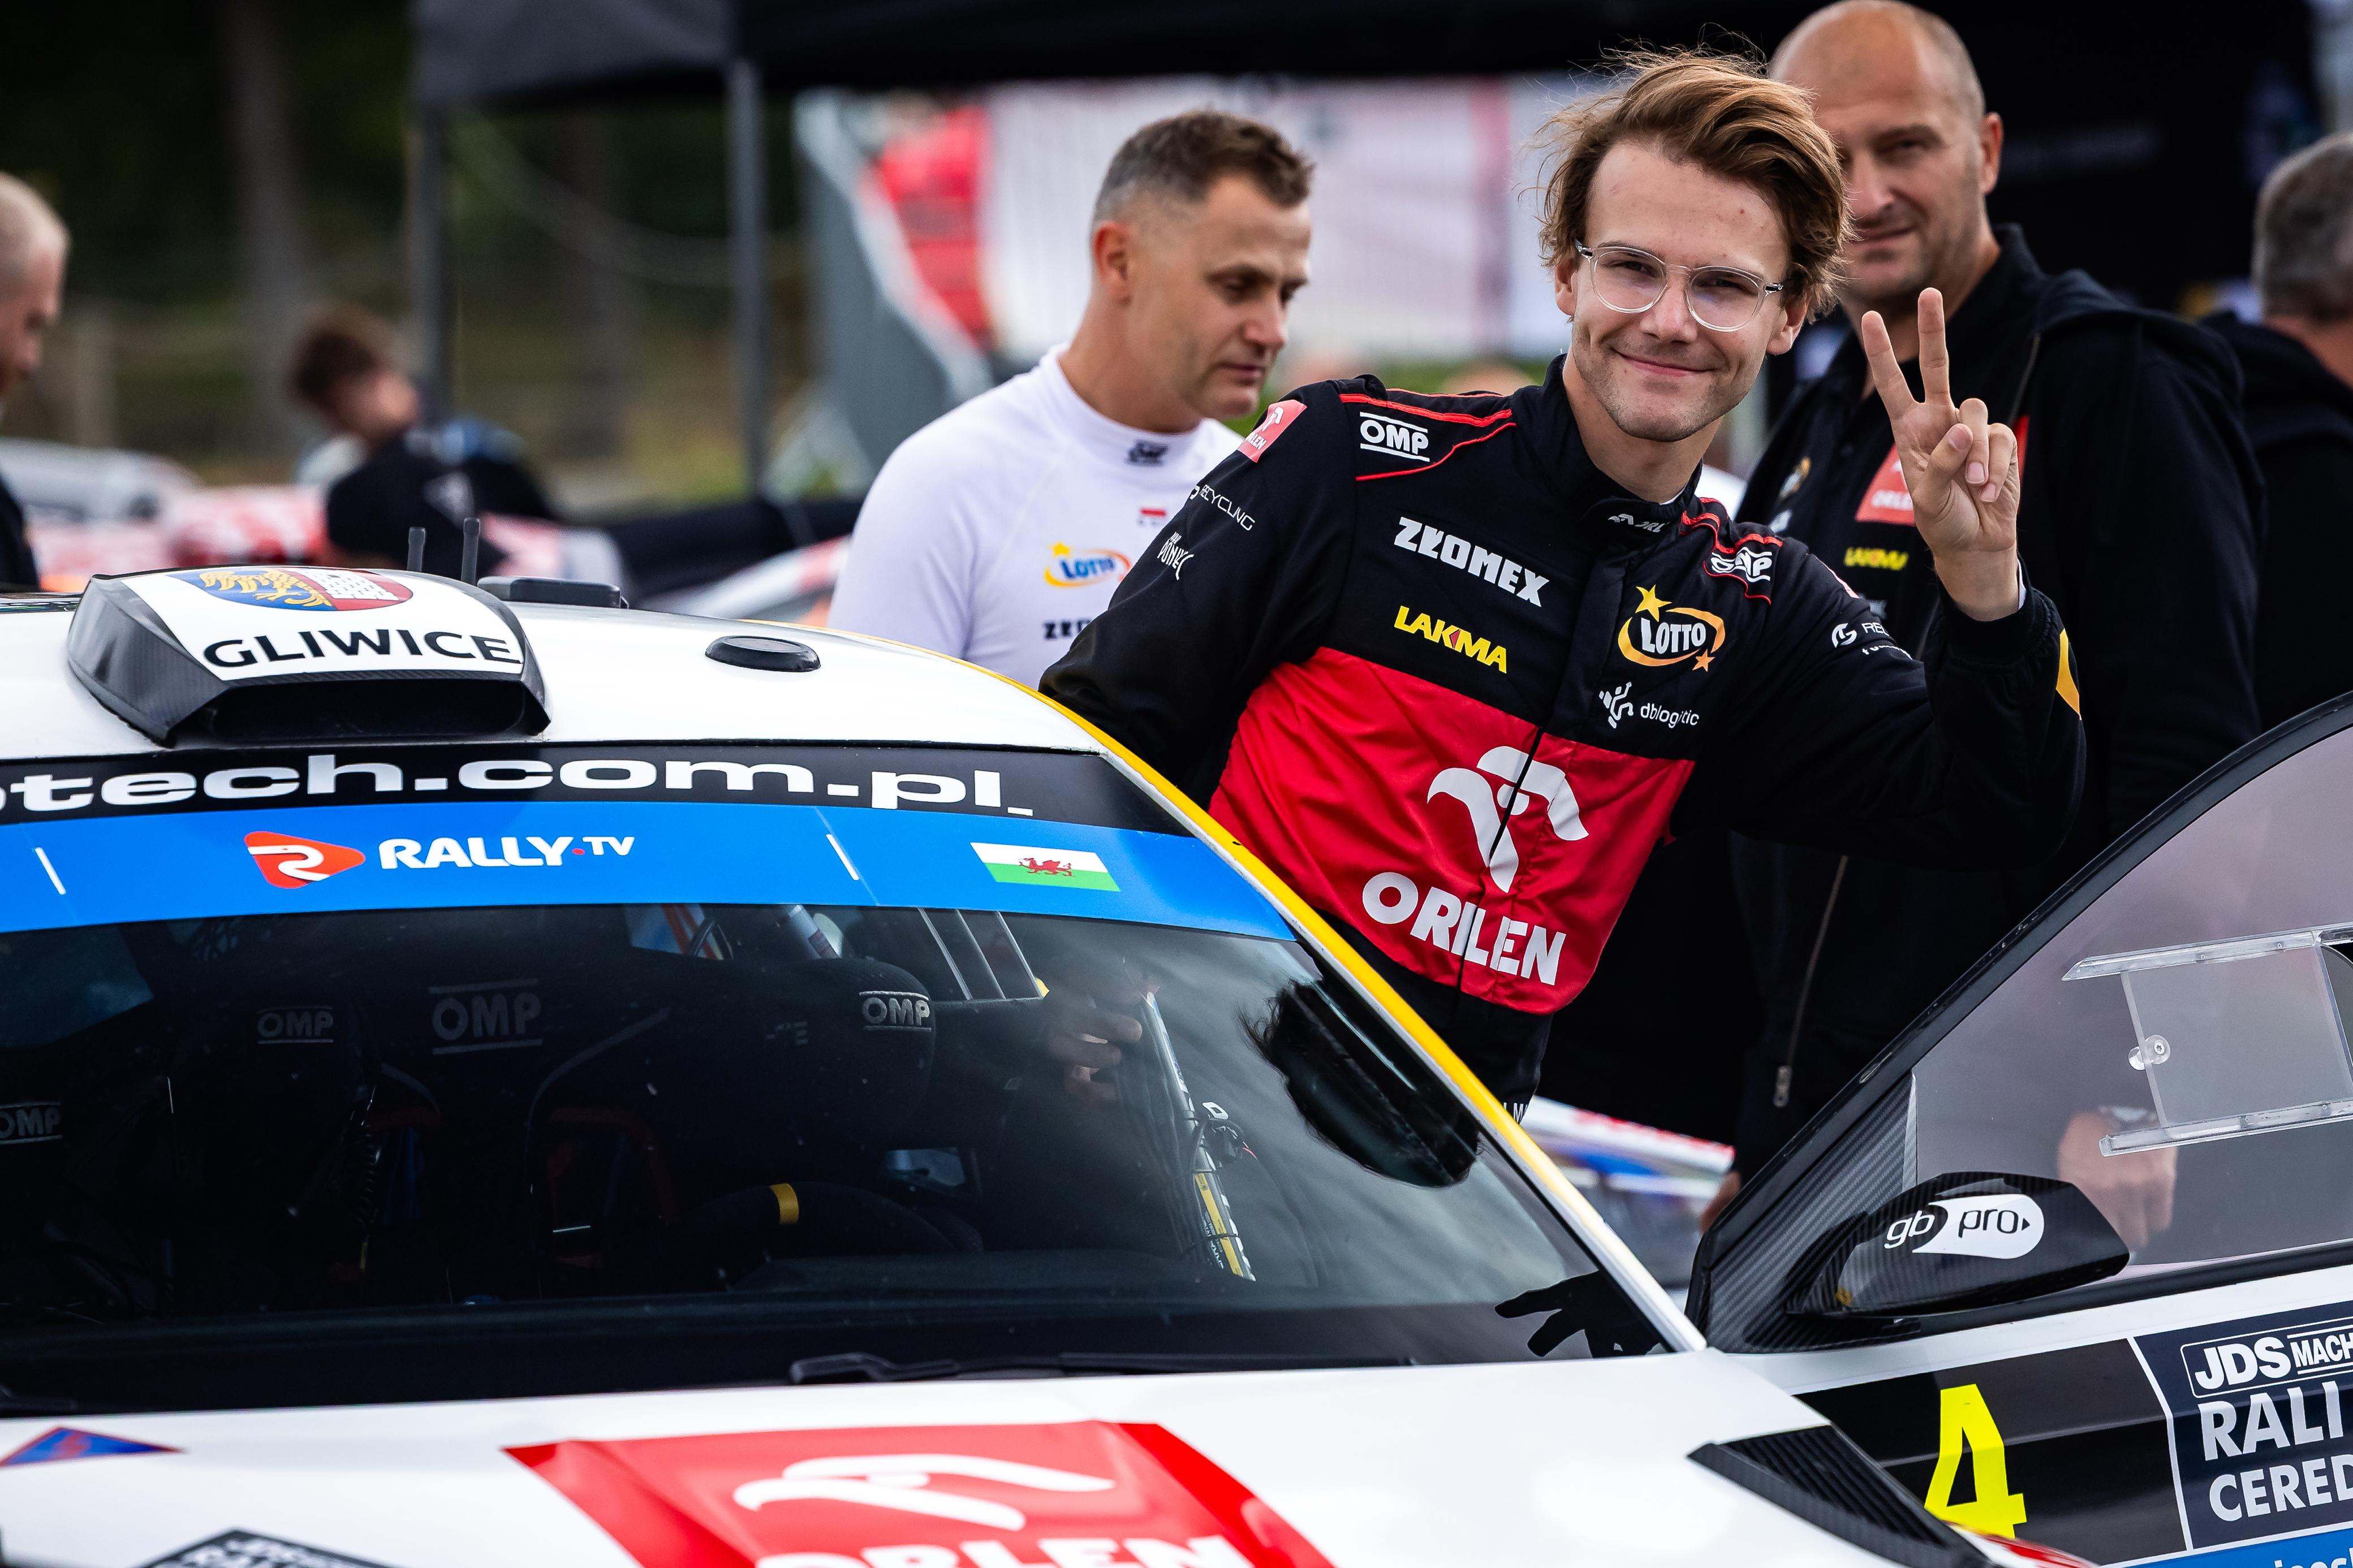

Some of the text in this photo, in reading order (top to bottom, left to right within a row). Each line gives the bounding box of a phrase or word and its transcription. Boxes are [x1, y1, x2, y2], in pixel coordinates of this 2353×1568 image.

[1360, 420, 1429, 455] OMP
[1710, 552, 1772, 577] OMP
[202, 629, 522, 668] GLIWICE
[1394, 605, 1507, 673] LAKMA
[1641, 617, 1706, 654] LOTTO
[257, 1010, 333, 1038] OMP
[432, 992, 541, 1041] OMP
[861, 997, 930, 1026] OMP
[1884, 1209, 2019, 1249] gb pro
[2195, 1334, 2353, 1390] JDS MACH
[2197, 1380, 2344, 1461] RALI
[1925, 1383, 2027, 1539] 4
[2209, 1454, 2353, 1522] CERED
